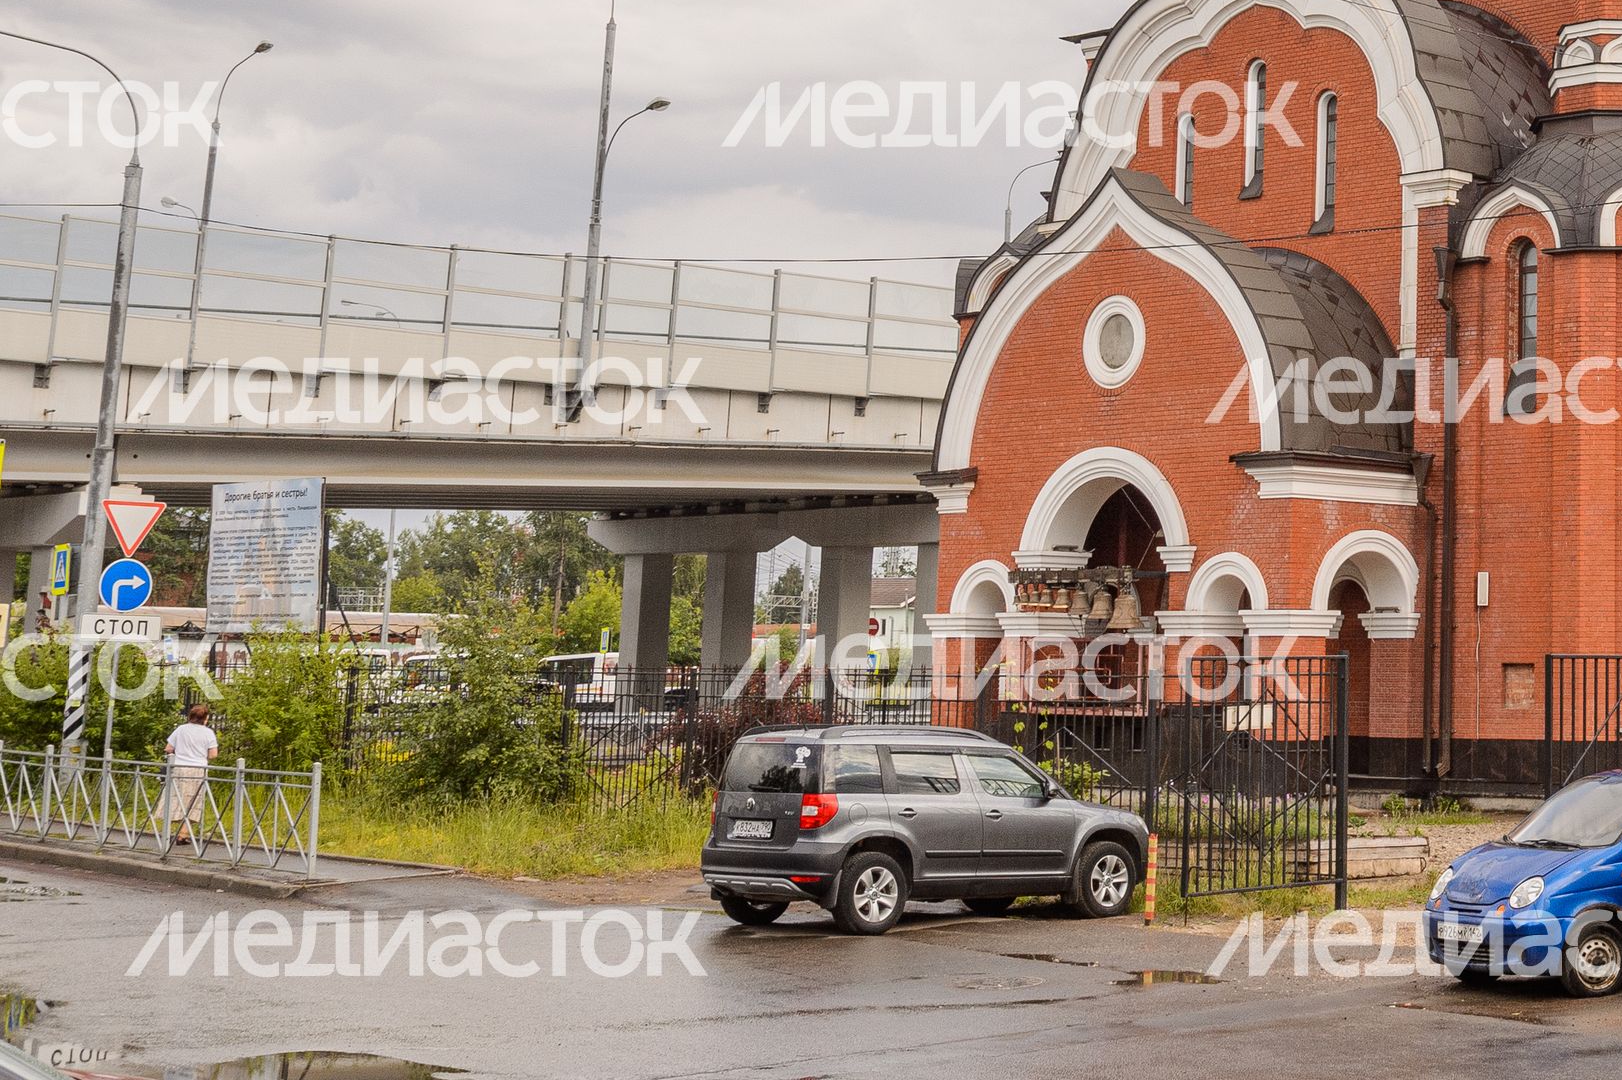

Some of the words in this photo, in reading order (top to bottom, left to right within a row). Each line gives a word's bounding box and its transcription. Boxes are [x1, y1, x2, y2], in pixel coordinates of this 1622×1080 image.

[224, 492, 251, 503] Дорогие
[253, 490, 273, 502] братья
[282, 488, 308, 500] сестры!
[94, 619, 149, 635] СТОП
